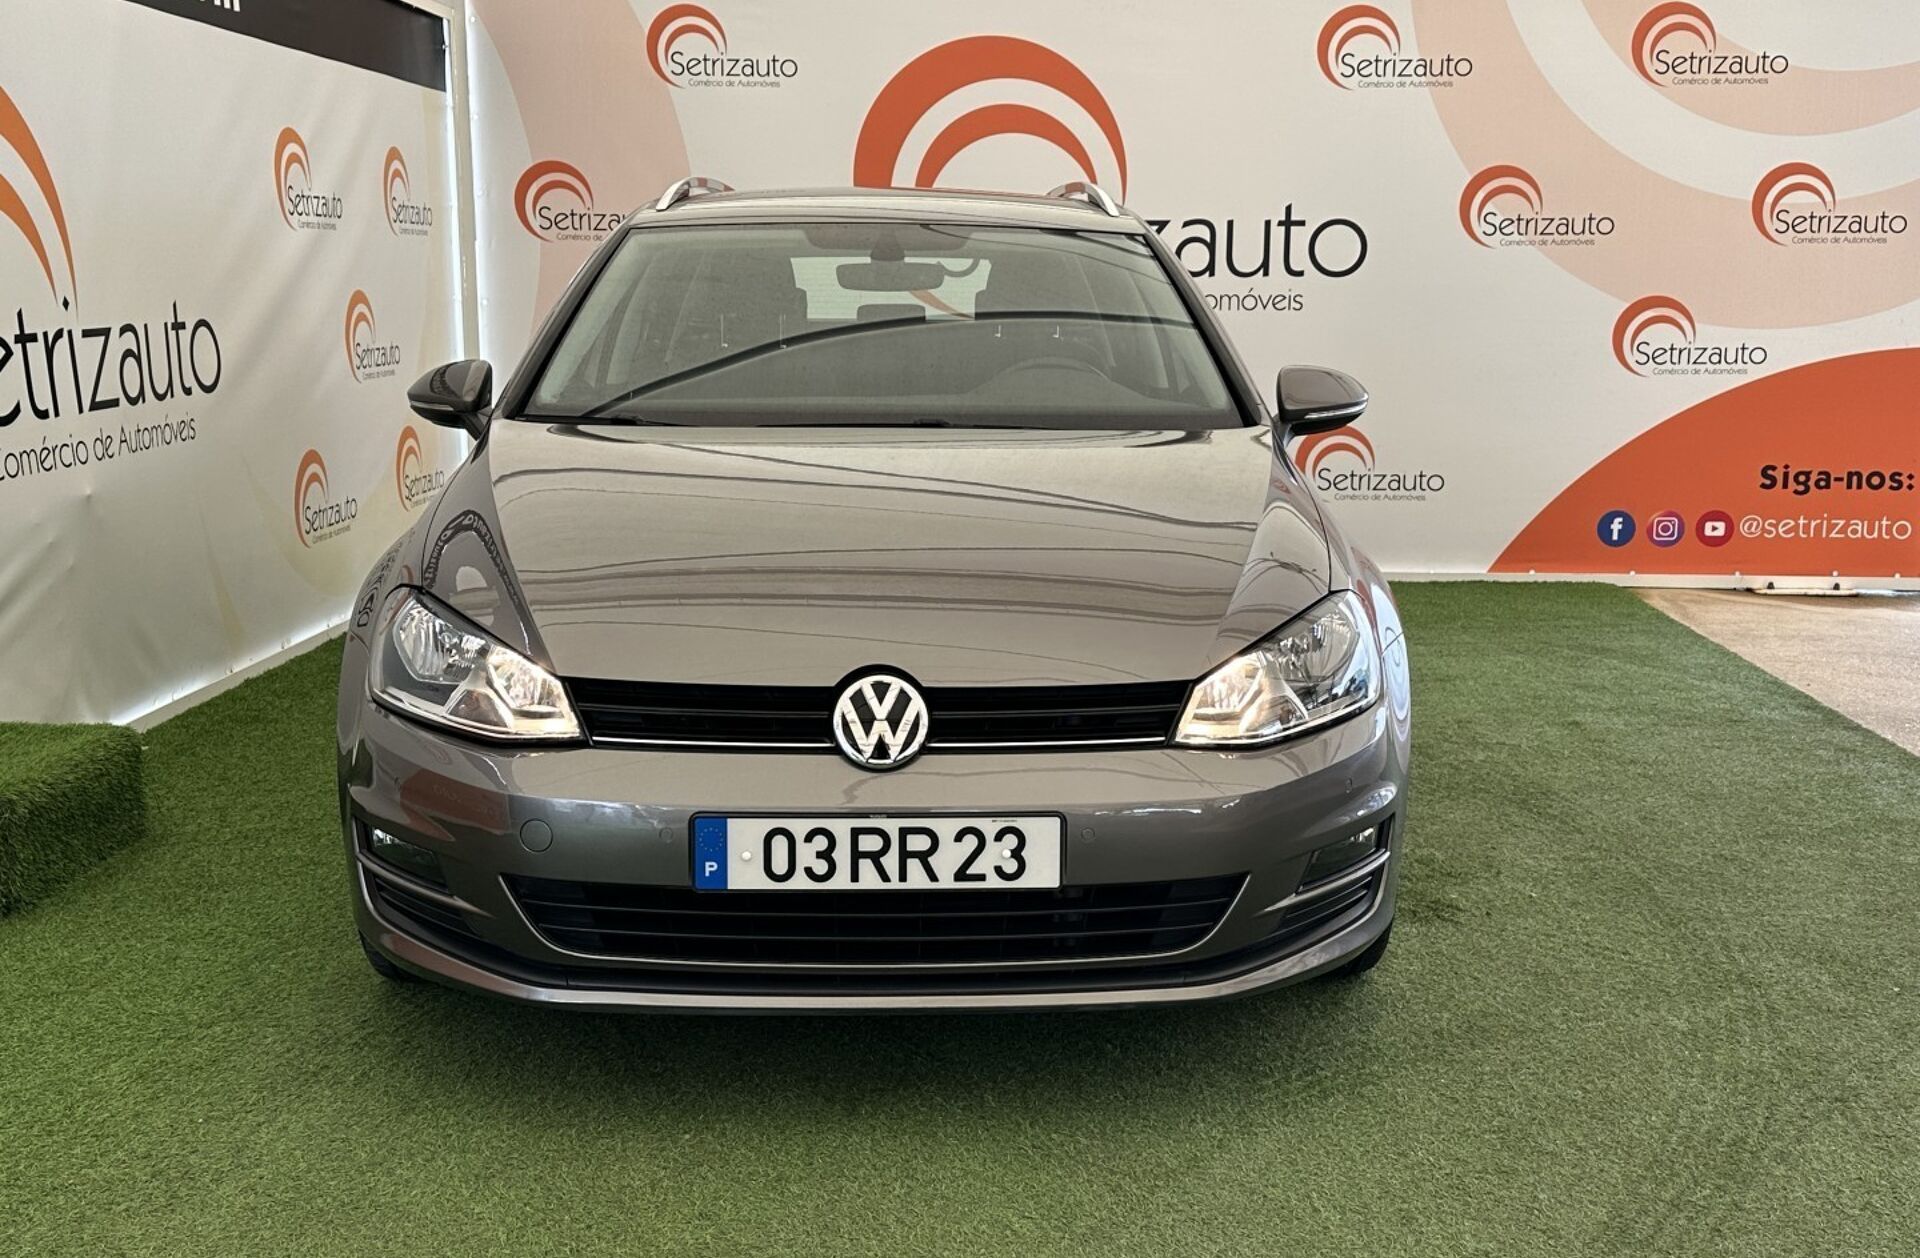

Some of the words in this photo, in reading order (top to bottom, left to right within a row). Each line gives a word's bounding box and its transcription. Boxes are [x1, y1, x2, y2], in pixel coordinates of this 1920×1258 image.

[670, 51, 798, 77] Setrizauto
[1340, 52, 1473, 78] Setrizauto
[1654, 49, 1789, 75] Setrizauto
[538, 206, 625, 231] Setriza
[1482, 211, 1615, 237] Setrizauto
[1774, 209, 1908, 234] Setrizauto
[1635, 341, 1768, 366] Setrizauto
[93, 427, 115, 462] de
[118, 412, 197, 457] Automóveis
[1317, 467, 1445, 492] Setrizauto
[1759, 464, 1915, 496] Siga-nos:
[1739, 513, 1913, 540] @setrizauto
[705, 862, 718, 877] P
